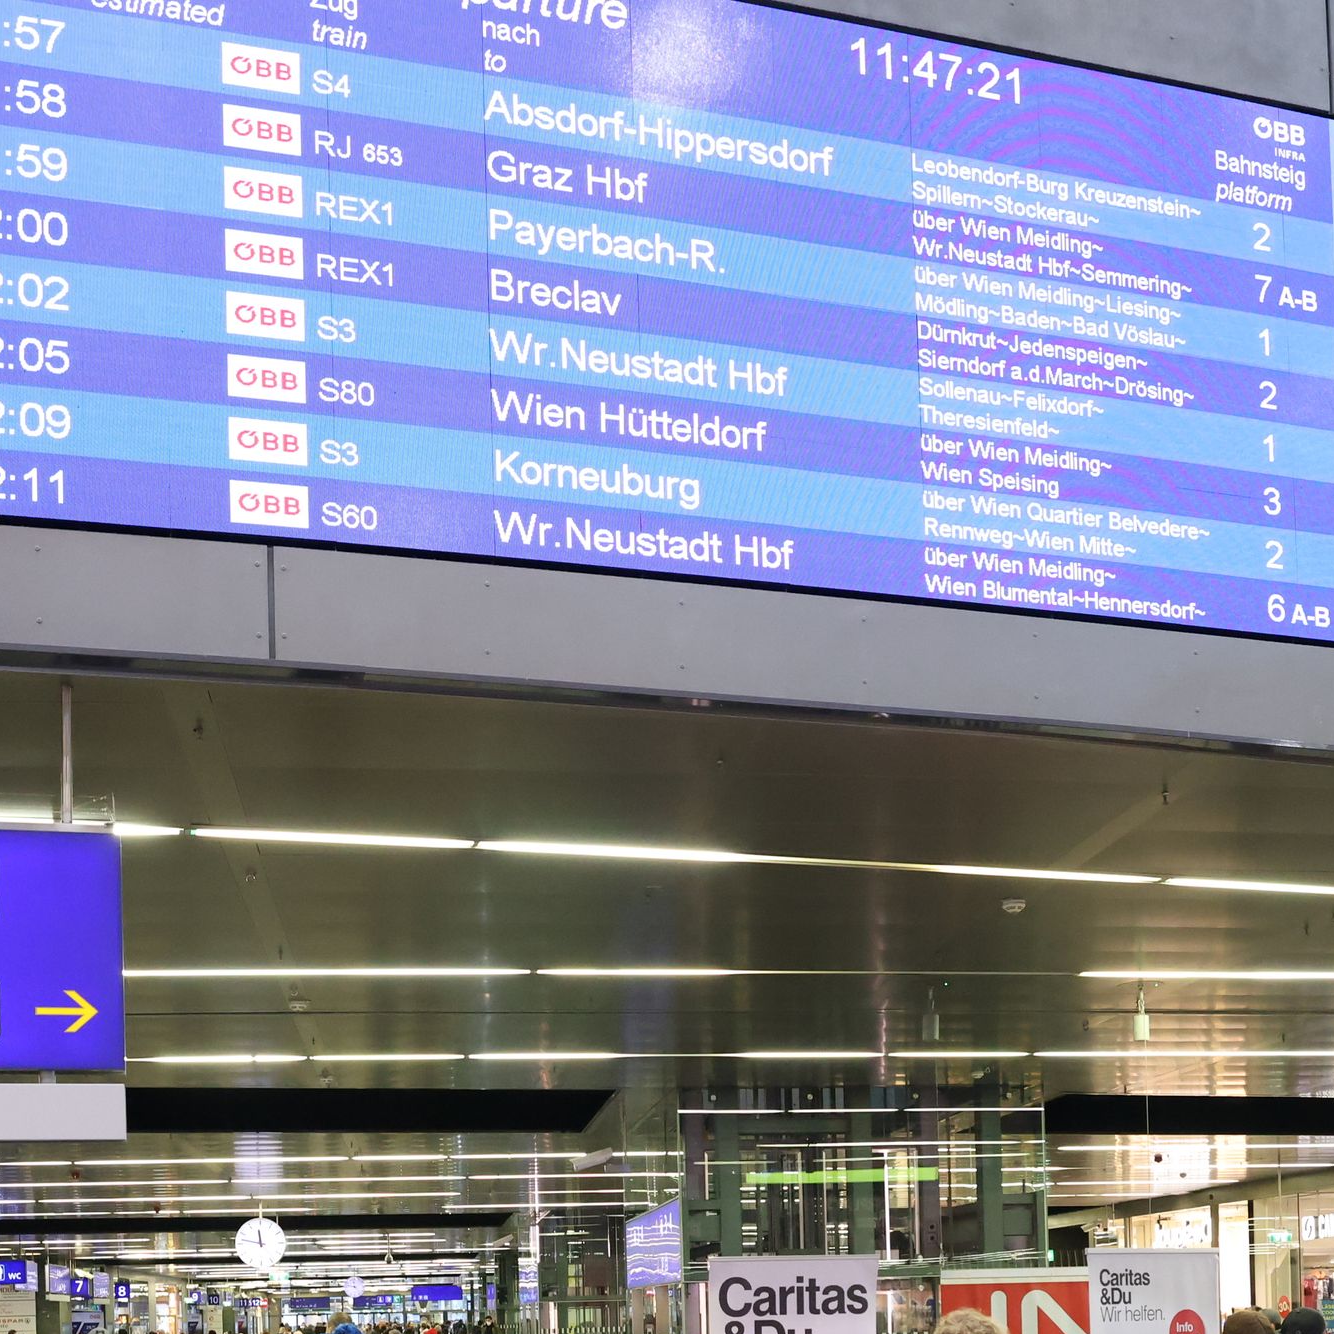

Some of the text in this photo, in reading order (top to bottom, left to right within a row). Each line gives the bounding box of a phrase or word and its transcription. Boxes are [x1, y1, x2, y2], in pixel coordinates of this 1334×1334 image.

[313, 70, 350, 97] S4
[851, 38, 1020, 104] 11:47:21
[315, 131, 402, 166] RJ 653
[484, 91, 833, 176] Absdorf-Hippersdorf
[488, 151, 648, 203] Graz Hbf
[912, 153, 1068, 201] Leobendorf-Burg
[1216, 150, 1305, 190] Bahnsteig
[490, 209, 724, 273] Payerbach-R.
[913, 236, 1032, 272] Wr.Neustadt
[491, 269, 621, 315] Breclav
[1255, 275, 1317, 311] 7 A-B
[490, 328, 787, 396] Wr.Neustadt Hbf
[319, 378, 374, 406] S80
[491, 389, 766, 451] Wien Hütteldorf
[496, 450, 699, 510] Korneuburg
[322, 502, 377, 530] S60
[494, 510, 793, 569] Wr.Neustadt Hbf
[75, 1280, 84, 1294] 7
[117, 1286, 127, 1298] 8
[718, 1275, 870, 1317] Caritas
[1099, 1269, 1151, 1287] Caritas
[1100, 1287, 1132, 1305] &Du
[191, 1292, 199, 1302] 9
[1100, 1305, 1166, 1322] Wir helfen.
[1176, 1322, 1194, 1333] Info
